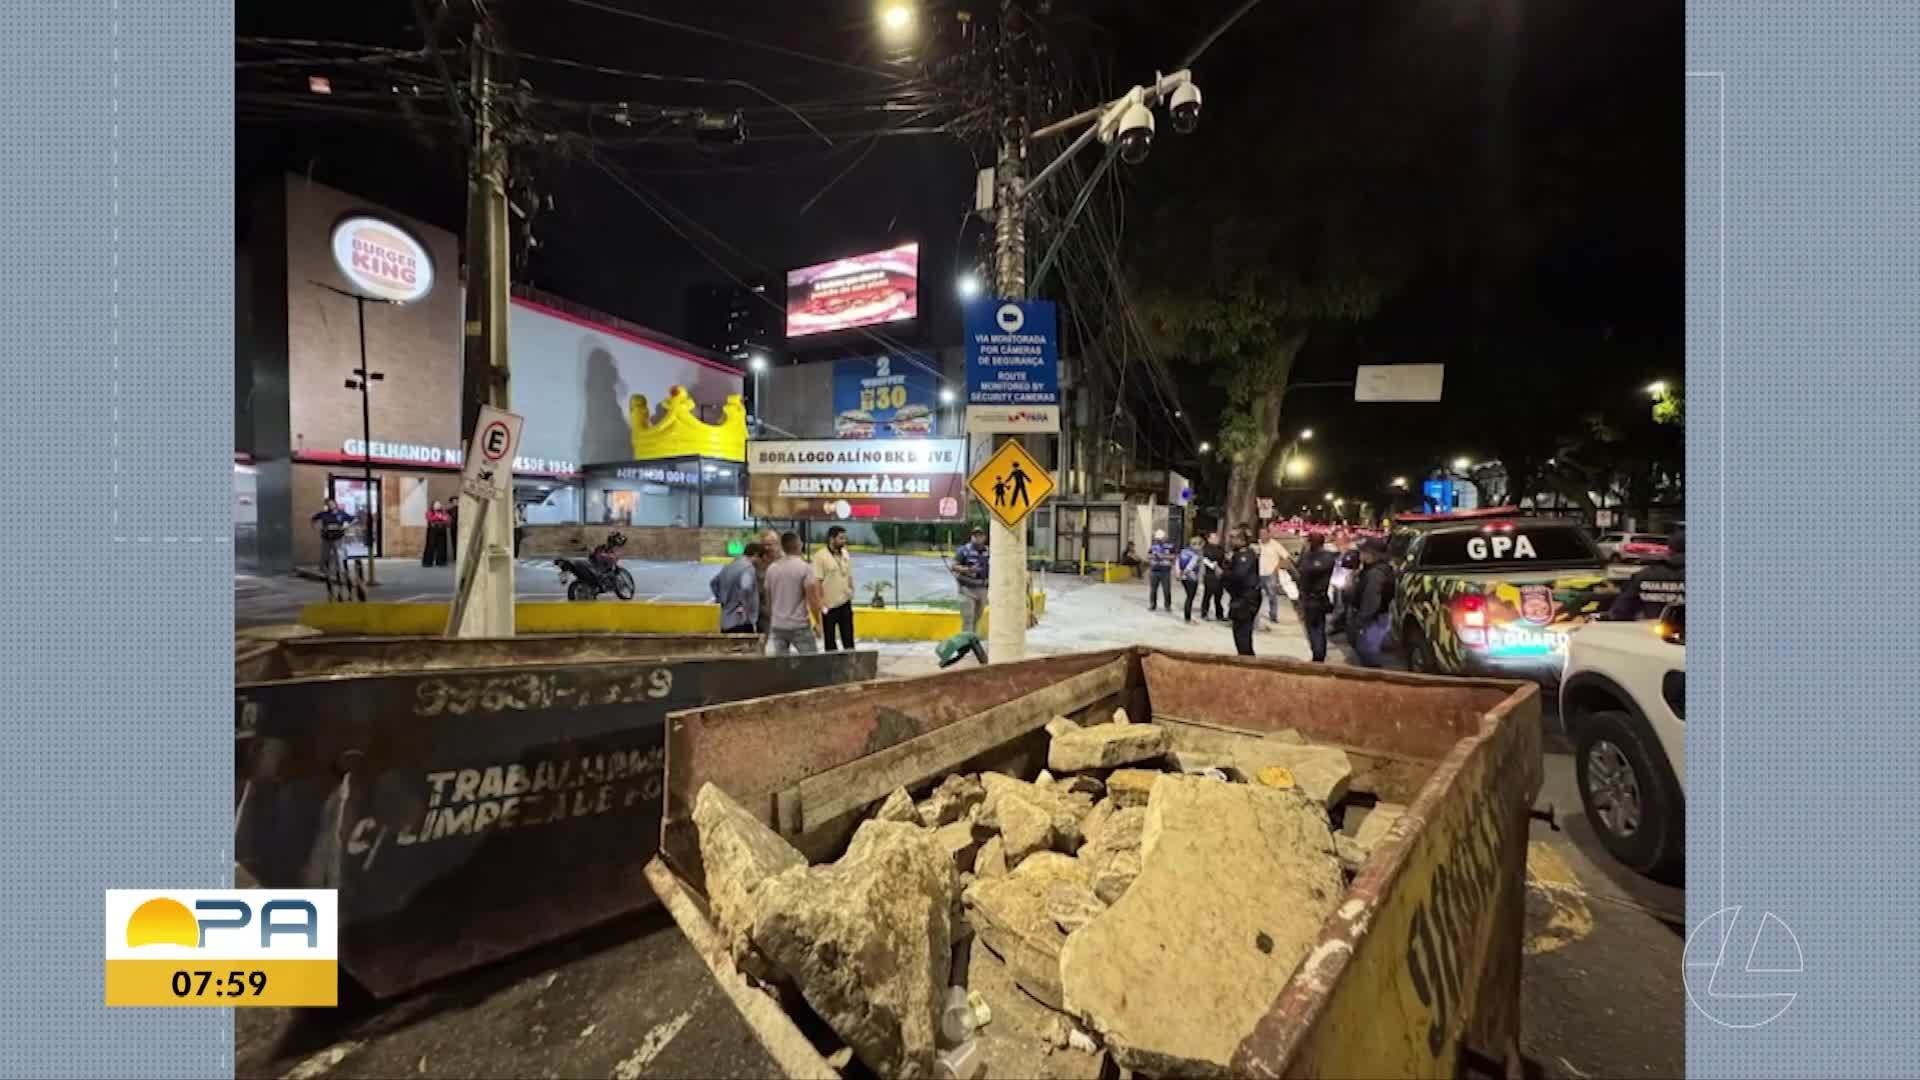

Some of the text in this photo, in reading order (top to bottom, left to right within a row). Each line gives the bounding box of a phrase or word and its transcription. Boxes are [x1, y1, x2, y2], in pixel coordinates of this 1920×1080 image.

[352, 238, 417, 269] BURGER
[352, 250, 417, 284] KING
[975, 335, 1046, 344] VIA MONITORADA
[980, 343, 1042, 354] POR CÂMERAS
[876, 356, 891, 377] 2
[977, 356, 1044, 367] DE SEGURANÇA
[997, 371, 1026, 381] ROUTE
[981, 382, 1045, 391] MONITORED BY
[876, 385, 907, 410] 30
[970, 392, 1056, 402] SECURITY CAMERAS
[487, 430, 505, 454] E
[444, 449, 462, 465] N
[512, 456, 544, 472] ESDE
[759, 447, 952, 463] BORA LOGO ALÍ NO BK DIVE
[778, 474, 930, 493] ABERTO ATÉ ÀS 4H
[1467, 534, 1537, 560] GPA
